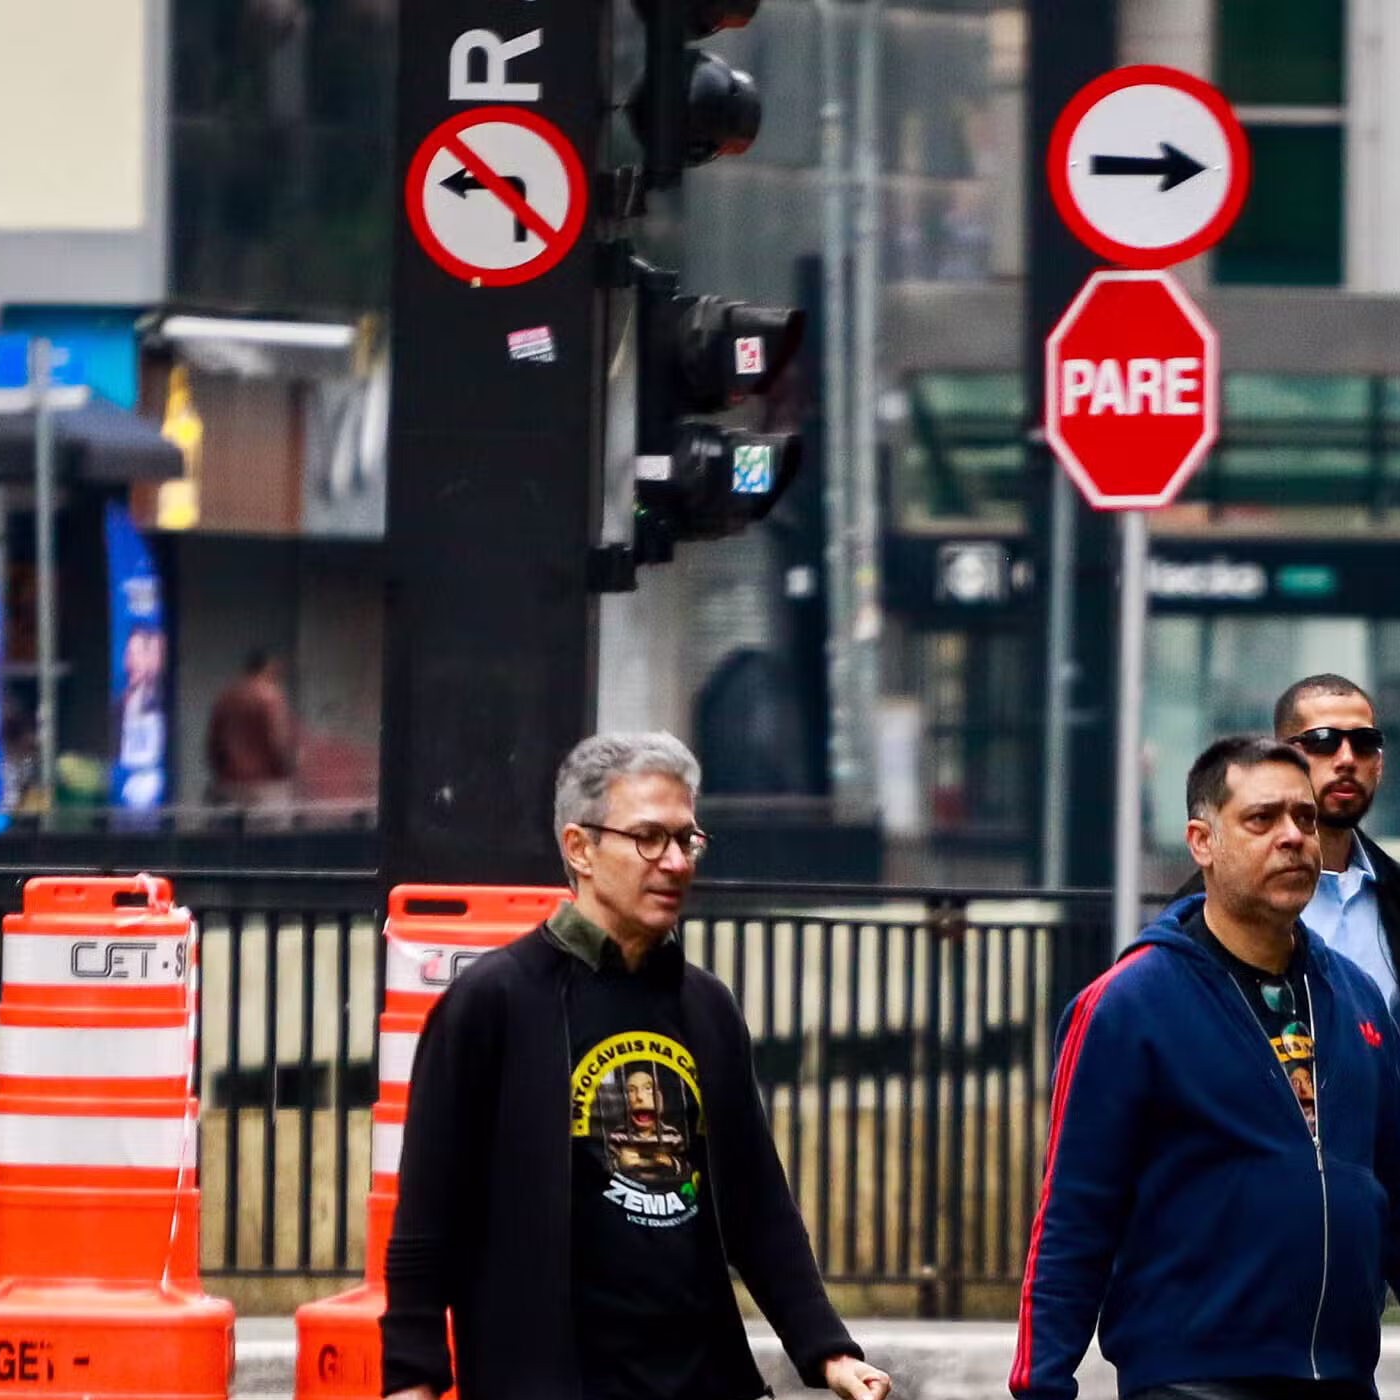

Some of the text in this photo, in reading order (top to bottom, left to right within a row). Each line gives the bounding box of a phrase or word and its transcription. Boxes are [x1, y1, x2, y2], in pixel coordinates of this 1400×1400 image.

[1062, 357, 1202, 417] PARE
[71, 942, 157, 978] CET
[649, 1041, 674, 1061] NA
[602, 1179, 686, 1216] ZEMA
